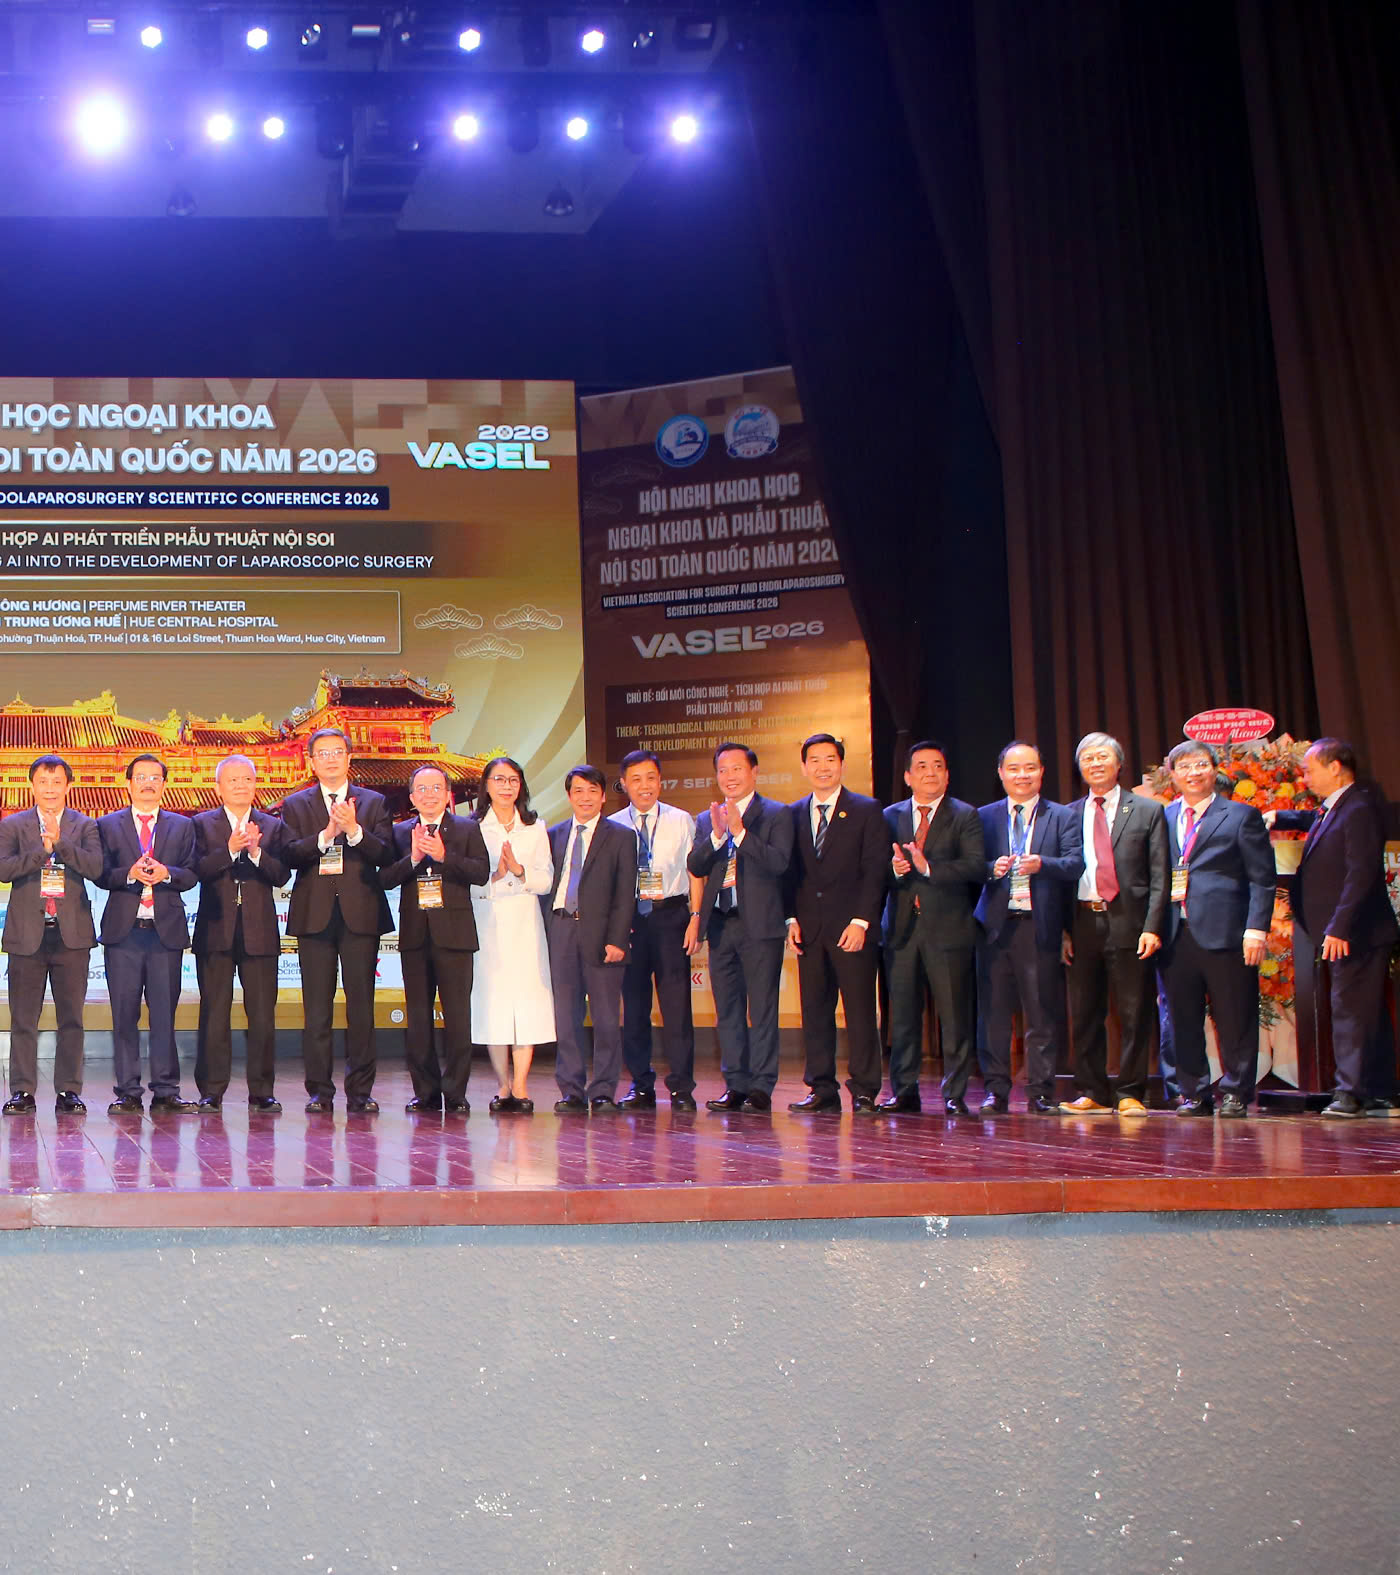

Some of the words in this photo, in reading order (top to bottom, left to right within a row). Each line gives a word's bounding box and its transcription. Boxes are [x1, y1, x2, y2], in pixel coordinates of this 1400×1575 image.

[1, 403, 71, 434] HỌC
[77, 403, 177, 434] NGOẠI
[184, 404, 275, 428] KHOA
[477, 424, 548, 441] 2026
[27, 441, 115, 472] TOÀN
[120, 439, 213, 475] QUỐC
[220, 442, 292, 473] NĂM
[297, 447, 376, 473] 2026
[406, 441, 550, 470] VASEL
[148, 491, 238, 505] SCIENTIFIC
[241, 492, 341, 505] CONFERENCE
[344, 492, 379, 505] 2026
[714, 477, 761, 505] KHOA
[2, 530, 39, 549] HỢP
[41, 531, 59, 546] AI
[63, 528, 108, 546] PHÁT
[110, 526, 160, 546] TRIỂN
[164, 526, 211, 546] PHẪU
[213, 528, 270, 550] THUẬT
[273, 528, 303, 550] NỘI
[306, 532, 335, 547] SOI
[660, 519, 704, 546] KHOA
[706, 511, 729, 540] VÀ
[6, 554, 21, 567] AI
[25, 554, 62, 568] INTO
[64, 554, 96, 568] THE
[99, 554, 213, 568] DEVELOPMENT
[216, 554, 238, 568] OF
[241, 555, 360, 568] LAPAROSCOPIC
[363, 555, 434, 568] SURGERY
[631, 559, 656, 581] SOI
[32, 599, 82, 612] HƯƠNG
[88, 600, 149, 612] PERFUME
[150, 600, 188, 612] RIVER
[188, 600, 246, 612] THEATER
[603, 594, 638, 607] VIETNAM
[638, 589, 688, 605] ASSOCIATION
[689, 588, 704, 599] FOR
[705, 583, 739, 598] SURGERY
[741, 582, 758, 594] AND
[666, 602, 707, 617] SCIENTIFIC
[708, 598, 756, 614] CONFERENCE
[3, 616, 50, 628] TRUNG
[52, 615, 92, 628] ƯƠNG
[93, 613, 122, 628] HUẾ
[129, 616, 156, 628] HUE
[157, 616, 217, 628] CENTRAL
[217, 616, 279, 628] HOSPITAL
[87, 633, 103, 643] TP.
[103, 632, 125, 643] Huế
[176, 633, 192, 643] Loi
[192, 633, 224, 645] Street,
[224, 633, 255, 643] Thuan
[255, 633, 276, 643] Hoa
[276, 633, 304, 645] Ward,
[304, 633, 325, 643] Hue
[325, 633, 346, 645] City,
[347, 633, 386, 644] Vietnam
[631, 626, 767, 659] VASEL
[755, 620, 825, 641] 2026
